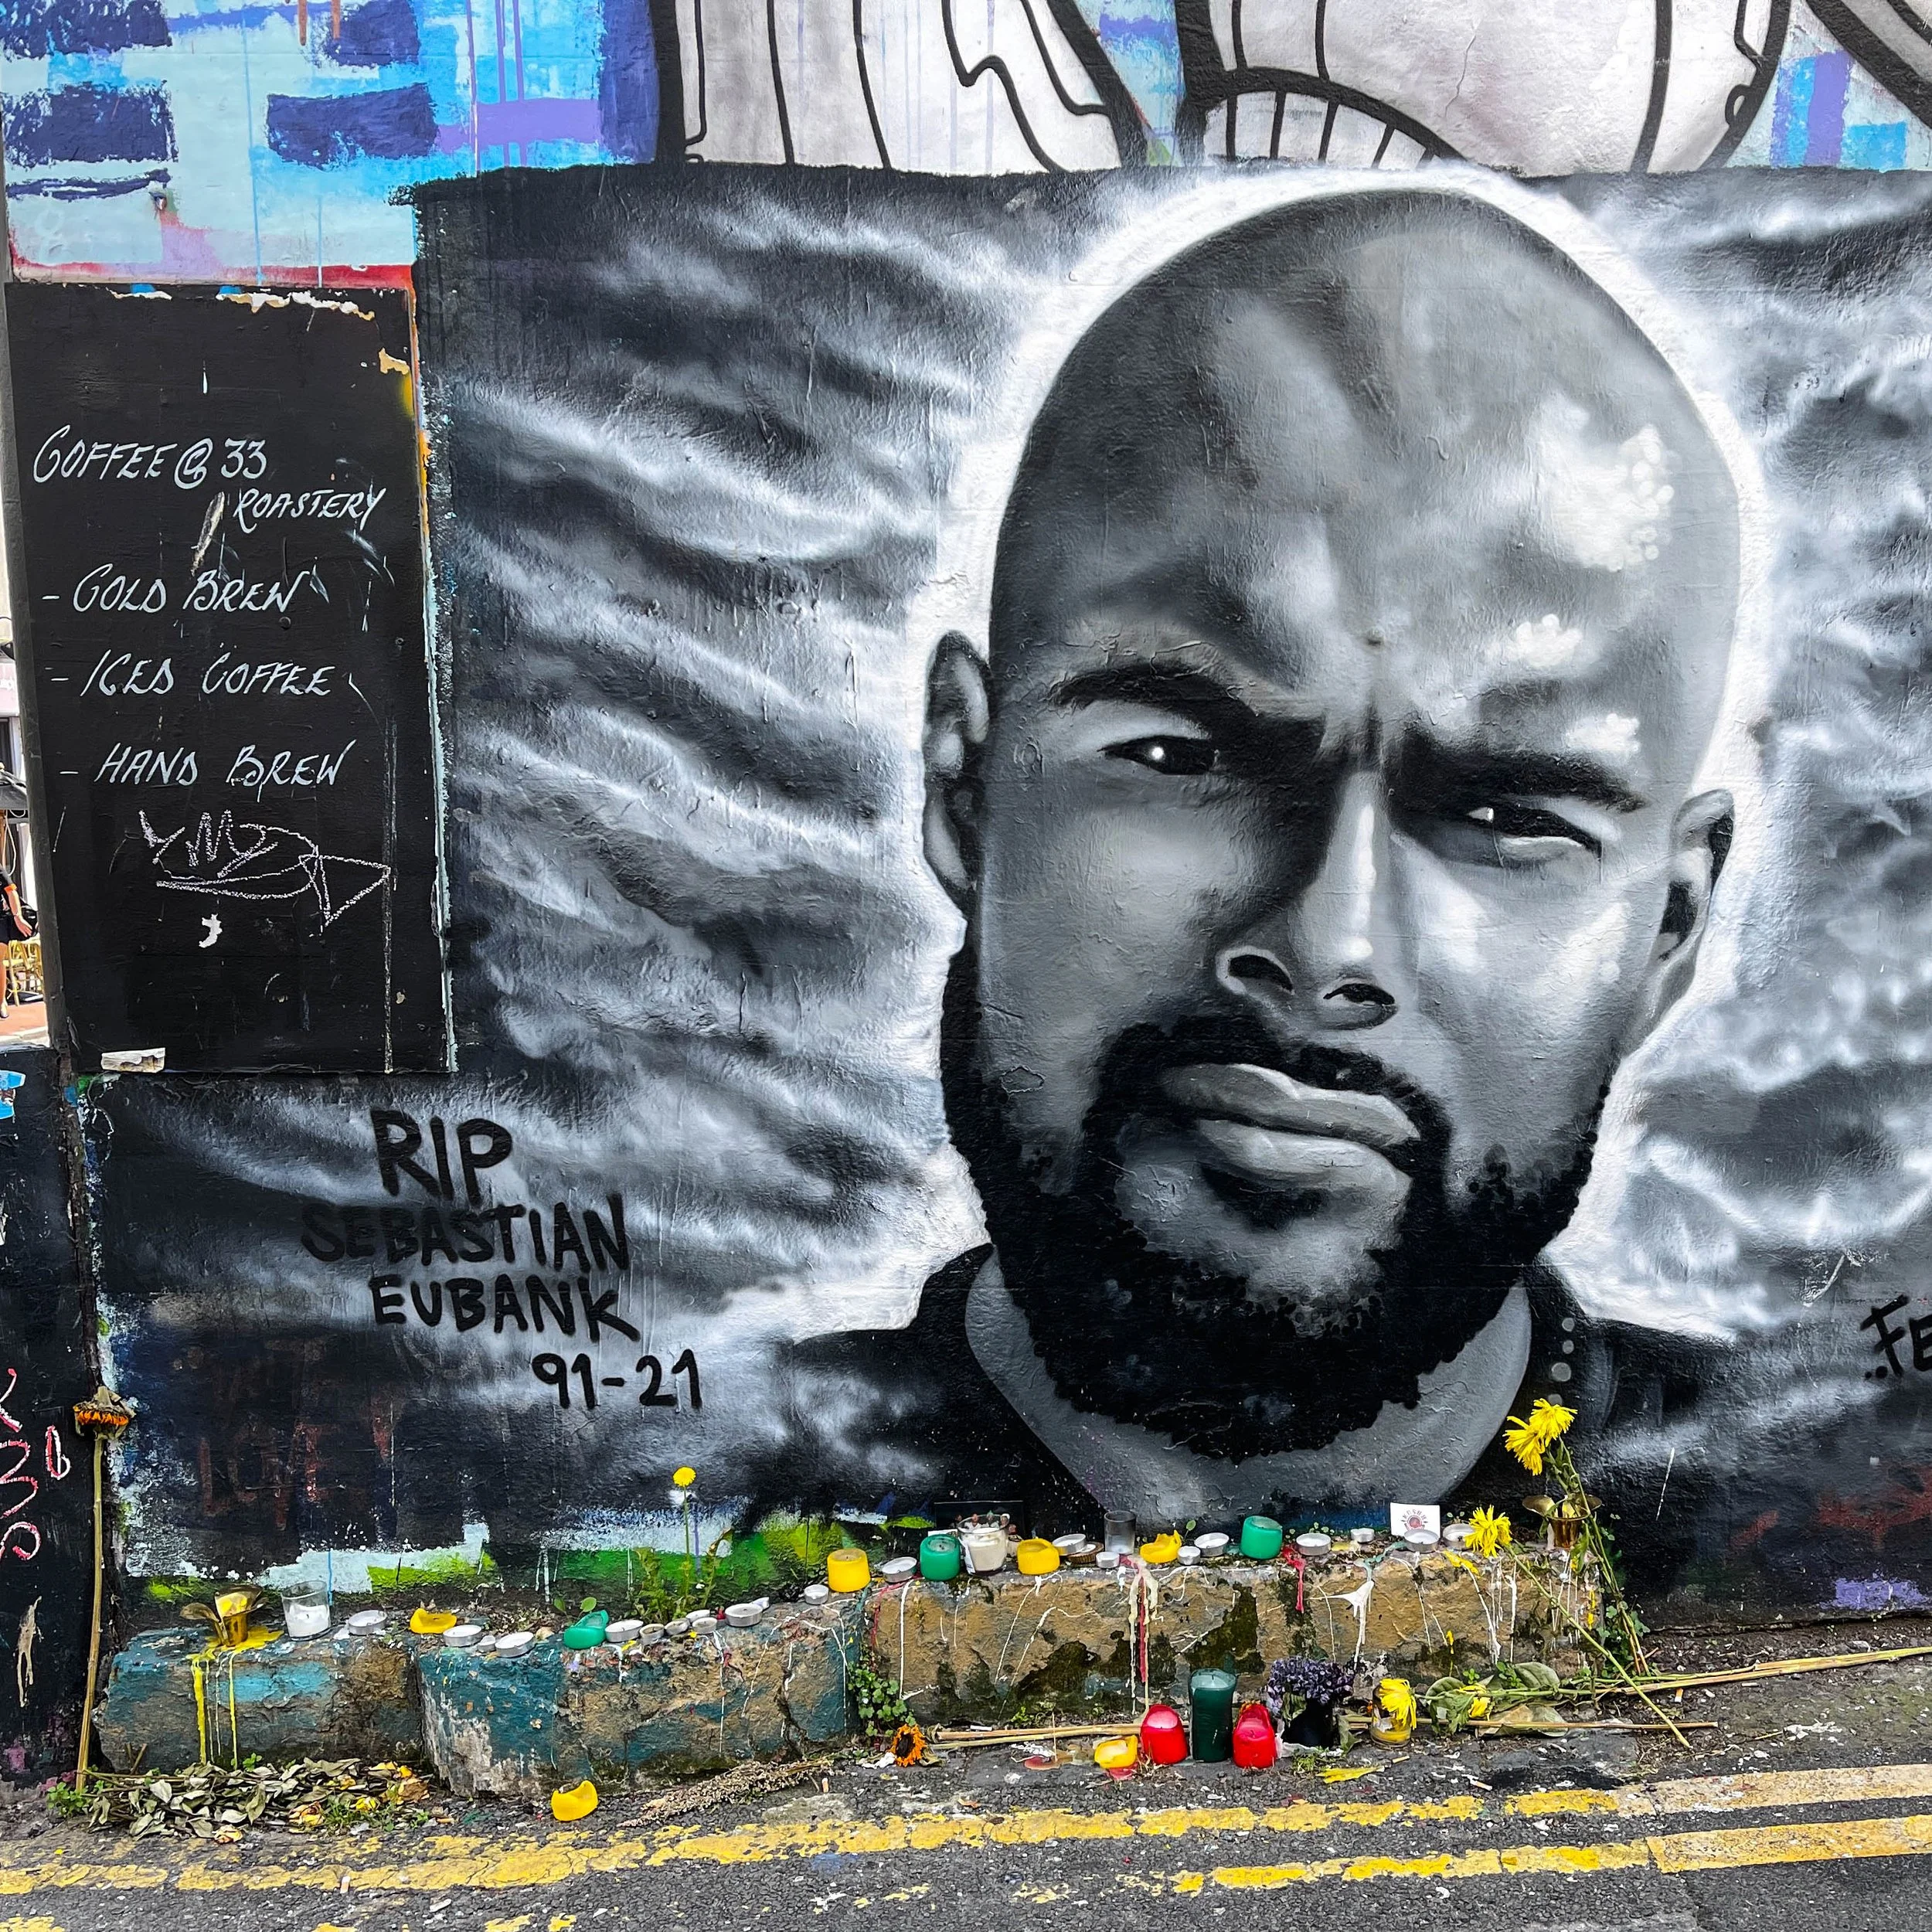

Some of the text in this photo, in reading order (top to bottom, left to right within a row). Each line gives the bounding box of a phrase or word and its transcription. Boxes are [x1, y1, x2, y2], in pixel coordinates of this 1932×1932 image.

[32, 424, 267, 490] COFFEE @ 33
[233, 487, 387, 534] ROASTERY
[72, 563, 168, 614] COLD
[182, 568, 311, 614] BREW
[80, 648, 175, 697] ICED
[201, 650, 336, 696] COFFEE
[93, 742, 199, 787] HAND
[225, 738, 357, 799] BREW
[369, 1107, 513, 1207] RIP
[300, 1192, 631, 1272] SEBASTIAN
[367, 1272, 641, 1343] EUBANK
[531, 1348, 703, 1410] 91-21
